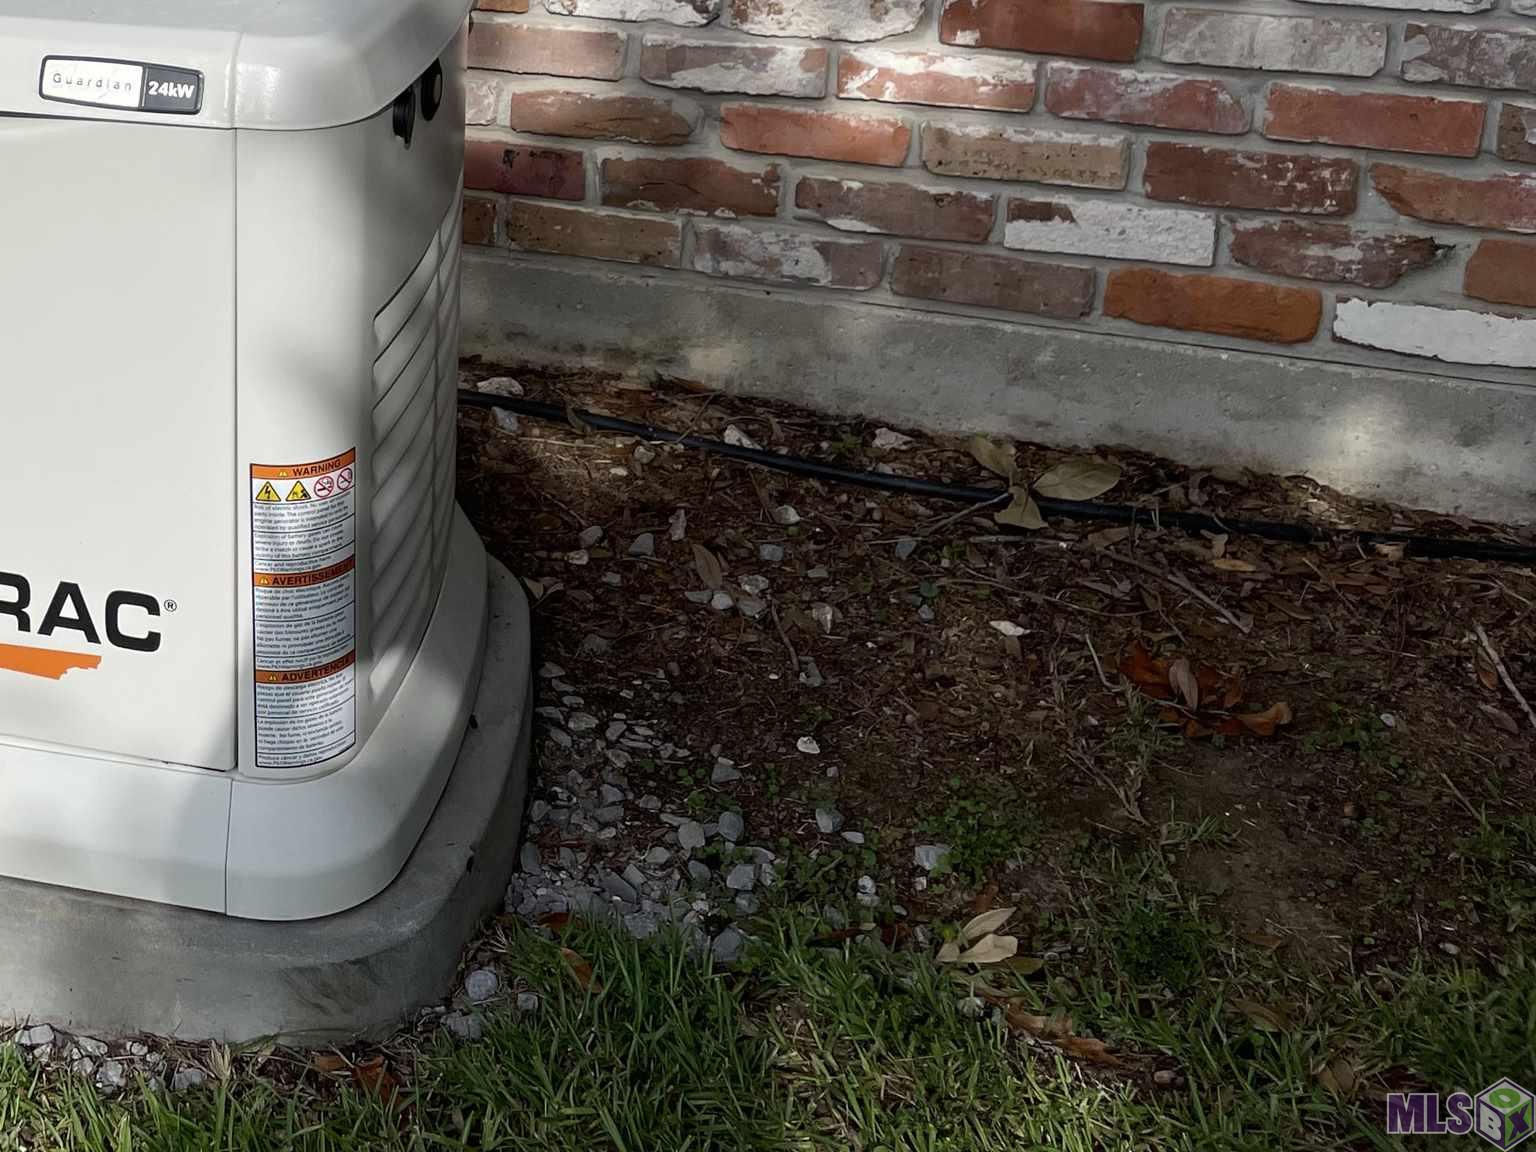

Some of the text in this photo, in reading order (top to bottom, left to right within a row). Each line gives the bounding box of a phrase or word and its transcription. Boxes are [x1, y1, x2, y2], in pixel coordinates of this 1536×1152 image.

[52, 72, 195, 98] Guardian 24kW
[292, 459, 341, 477] WARNING
